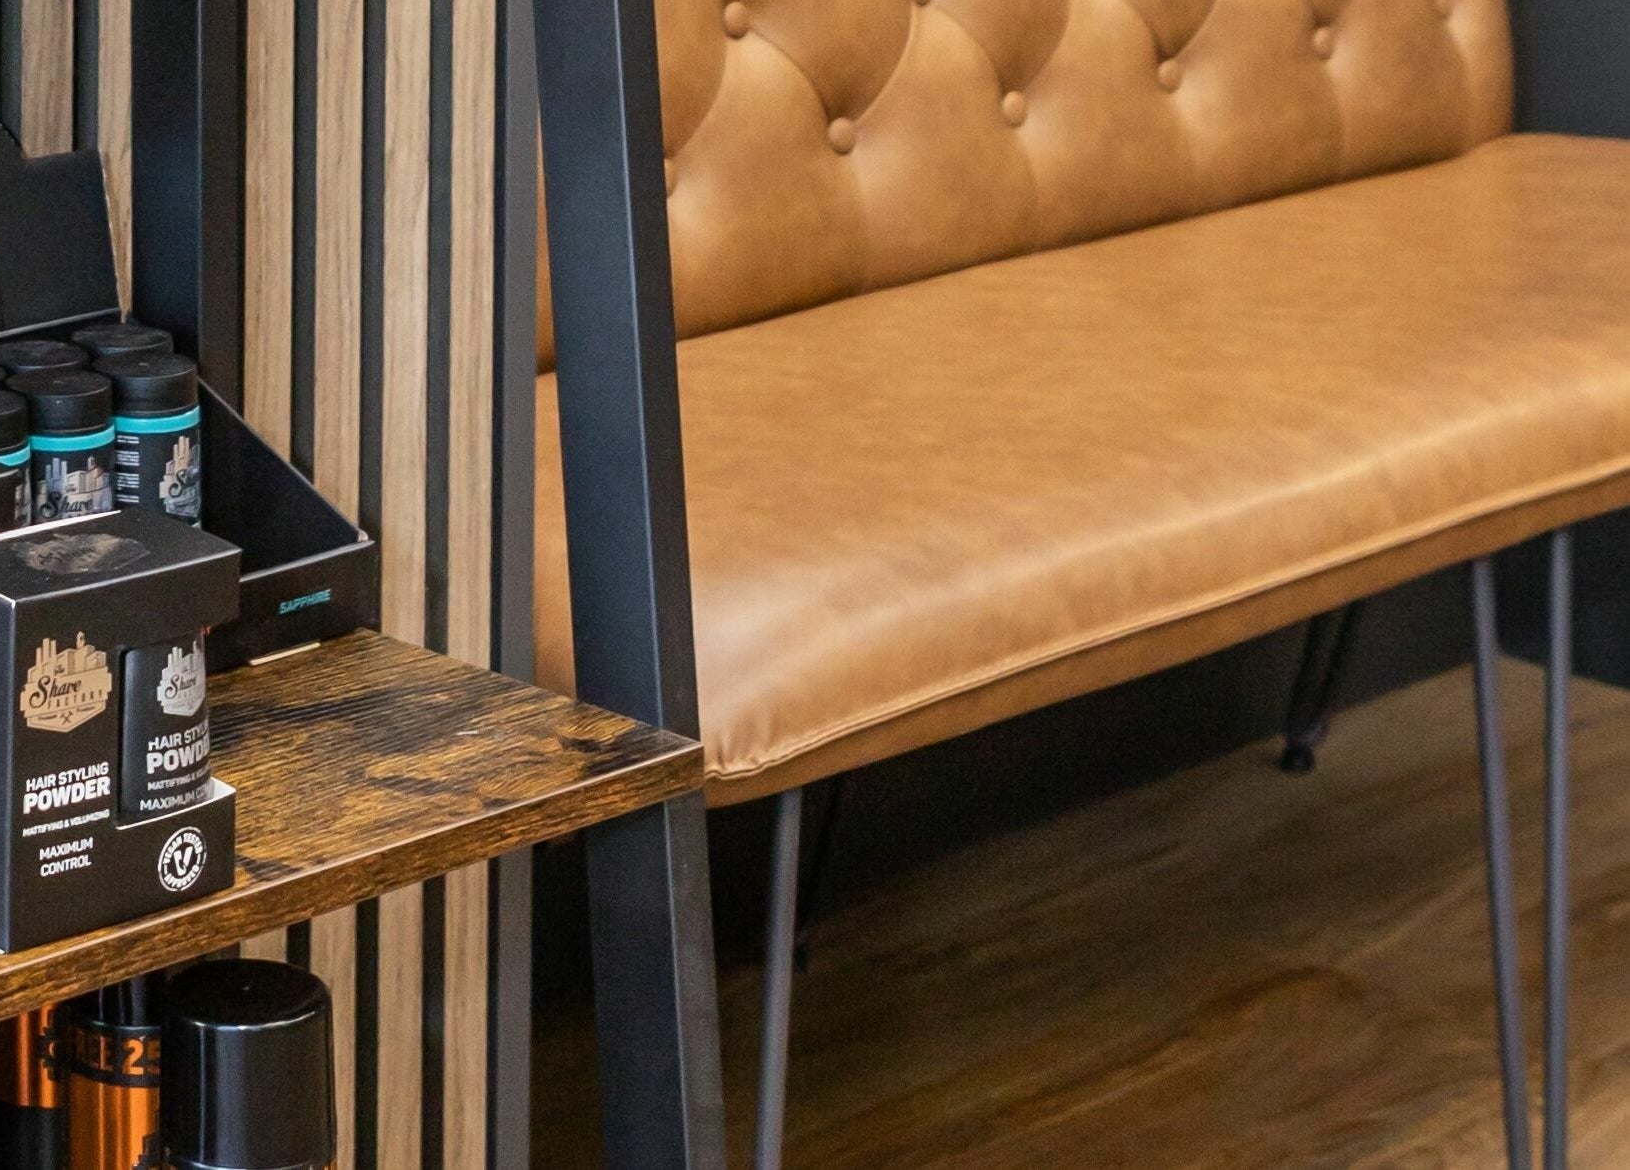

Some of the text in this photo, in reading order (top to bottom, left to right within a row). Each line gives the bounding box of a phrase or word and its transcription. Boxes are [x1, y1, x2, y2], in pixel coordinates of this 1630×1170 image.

[148, 732, 181, 751] HAIR
[26, 761, 109, 792] HAIR STYLING
[23, 776, 111, 814] POWDER
[39, 837, 94, 861] MAXIMUM
[163, 835, 183, 864] VEGAN
[40, 854, 92, 878] CONTROL
